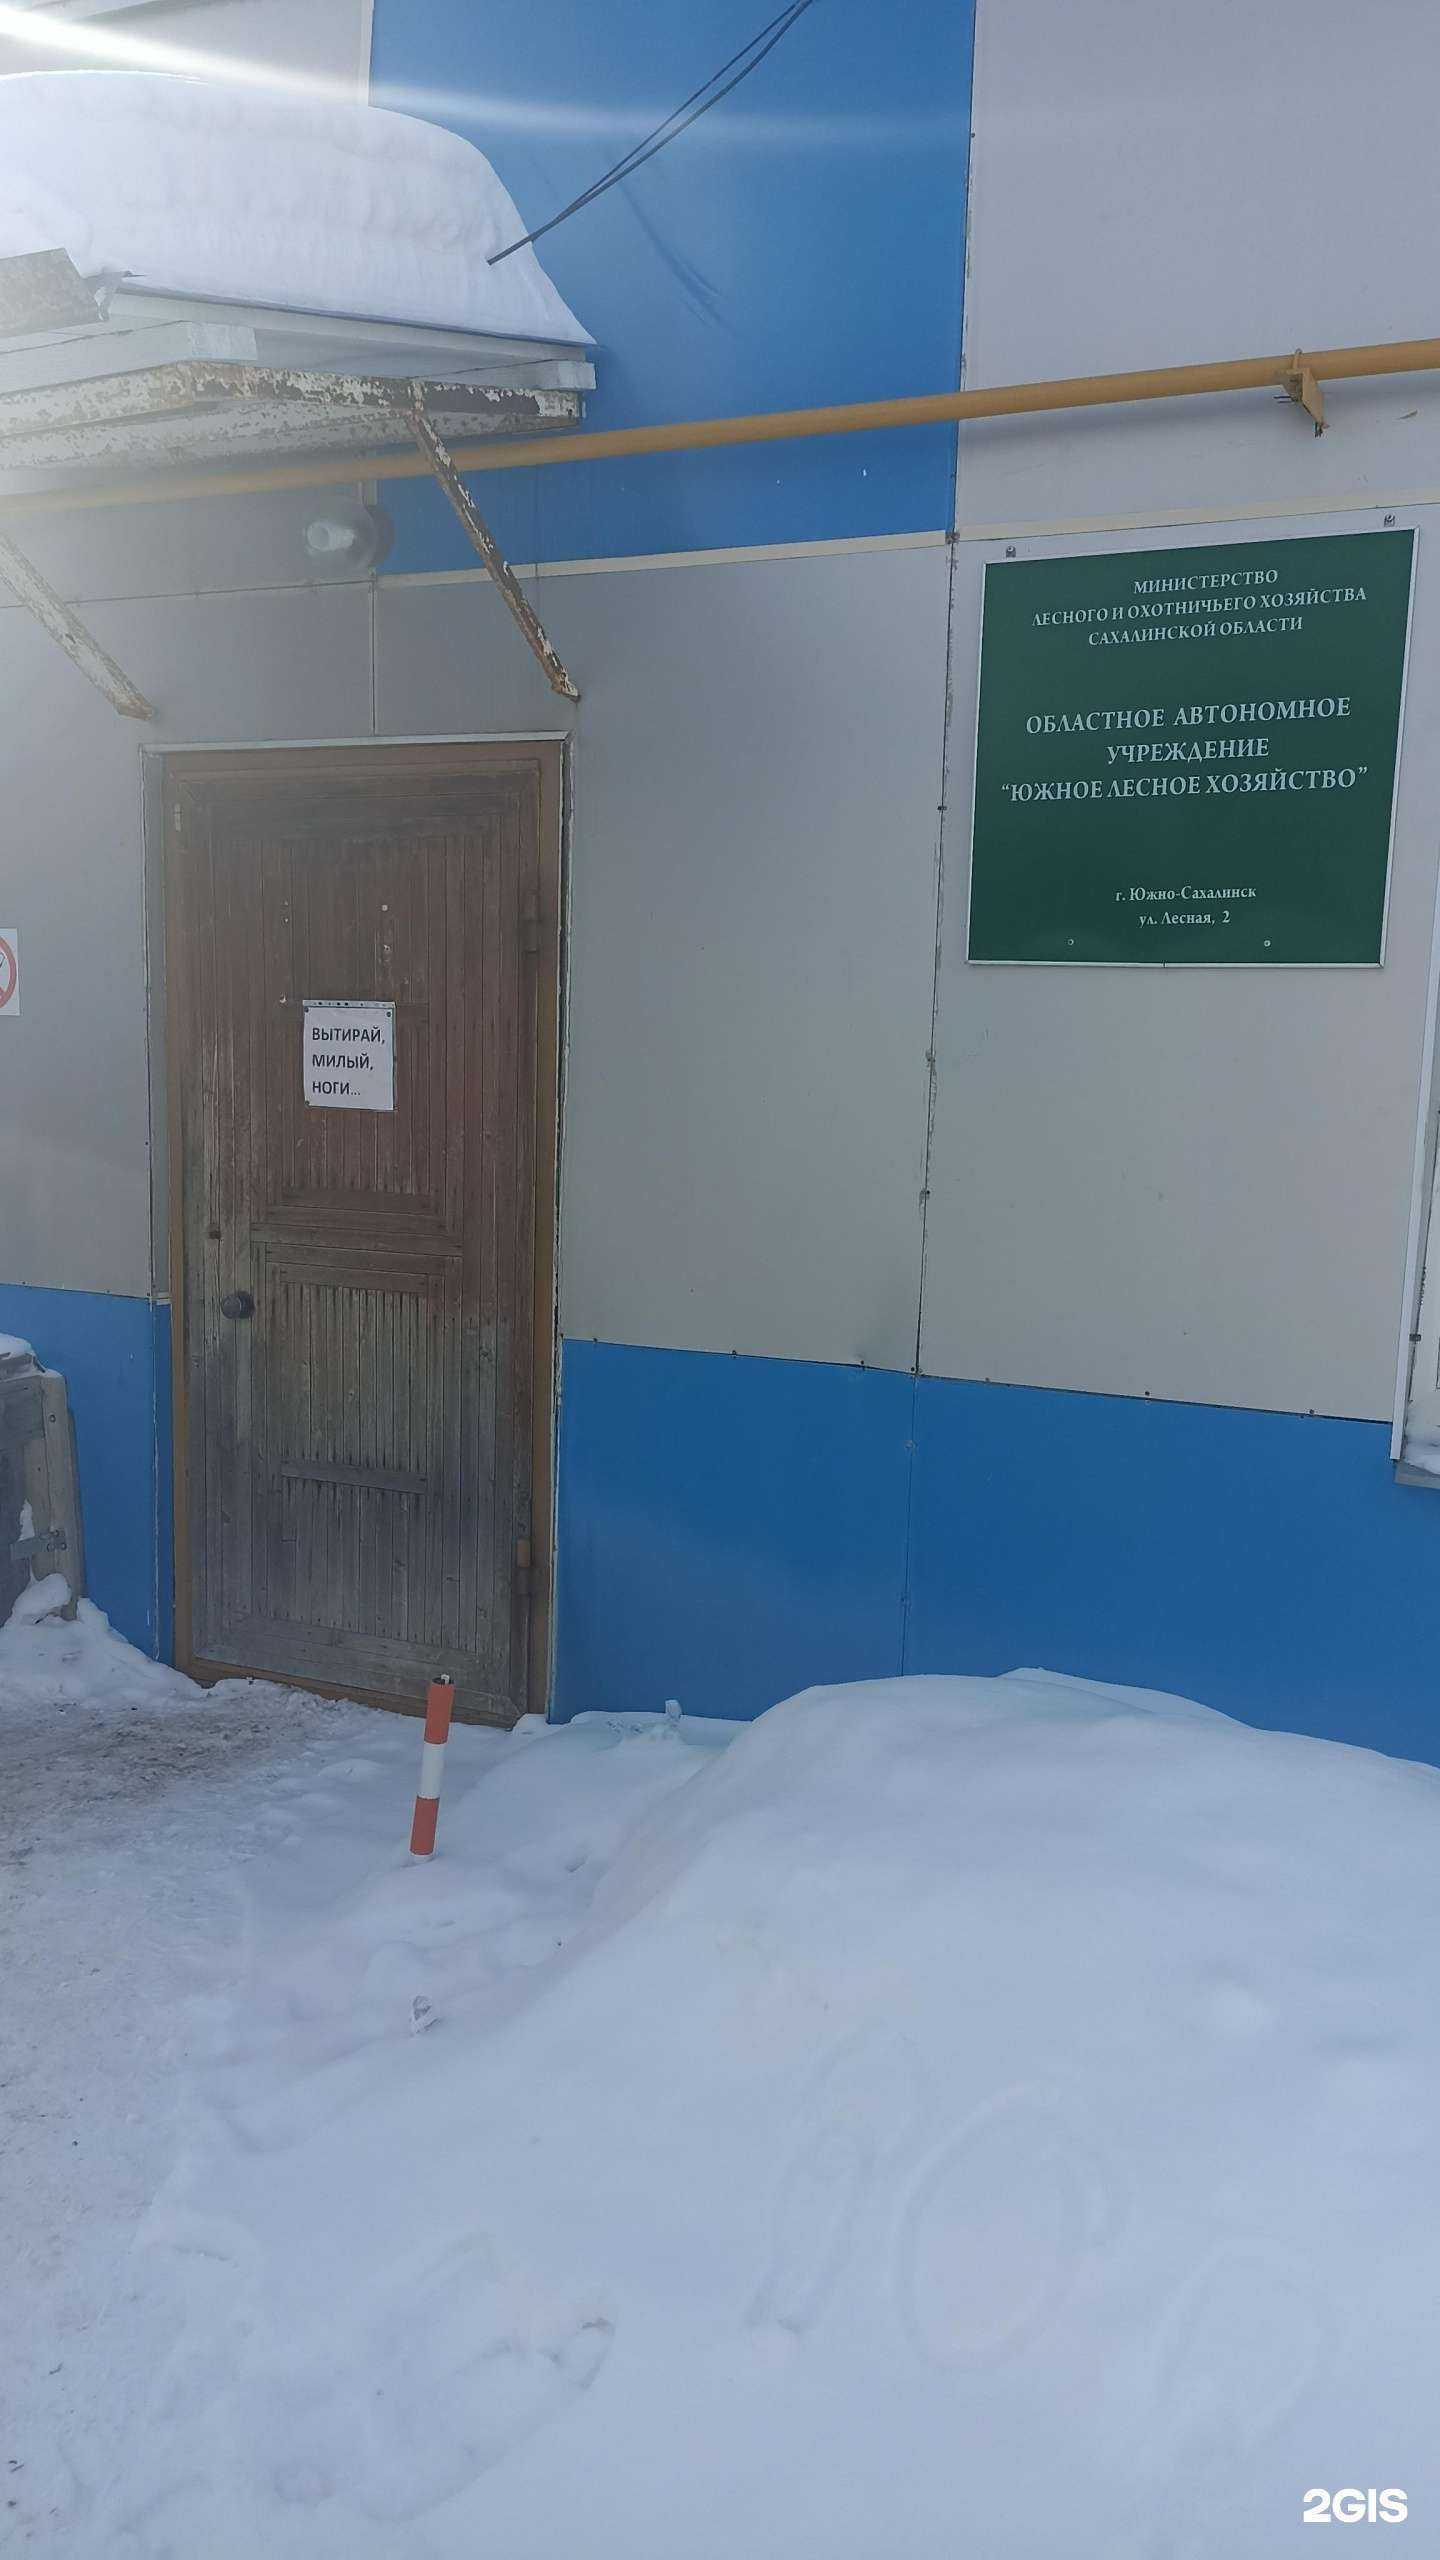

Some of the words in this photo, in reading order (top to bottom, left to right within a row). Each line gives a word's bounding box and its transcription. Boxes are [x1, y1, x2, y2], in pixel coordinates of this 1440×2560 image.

[1133, 569, 1278, 594] МИНИСТЕРСТВО
[1031, 608, 1108, 626] ЛЕСНОГО
[1112, 606, 1123, 620] И
[1127, 596, 1256, 620] ОХОТНИЧЬЕГО
[1260, 587, 1367, 609] ХОЗЯЙСТВА
[1088, 621, 1216, 646] САХАЛИНСКОЙ
[1219, 617, 1303, 634] ОБЛАСТИ
[1026, 709, 1164, 734] ОБЛАСТНОЕ
[1173, 698, 1351, 726] АВТОНОМНОЕ
[1106, 738, 1269, 765] УЧРЕЖДЕНИЕ
[1107, 776, 1201, 799] ЛЕСНОЕ
[1115, 894, 1127, 902] г.
[1129, 885, 1257, 901] Южно-Сахалинск
[1139, 914, 1158, 927] ул.
[1161, 912, 1216, 926] Лесная,
[1222, 911, 1232, 924] 2
[311, 1025, 385, 1045] ВЫТИРАЙ,
[311, 1052, 373, 1071] МИЛЫЙ,
[312, 1080, 361, 1096] НОГИ...
